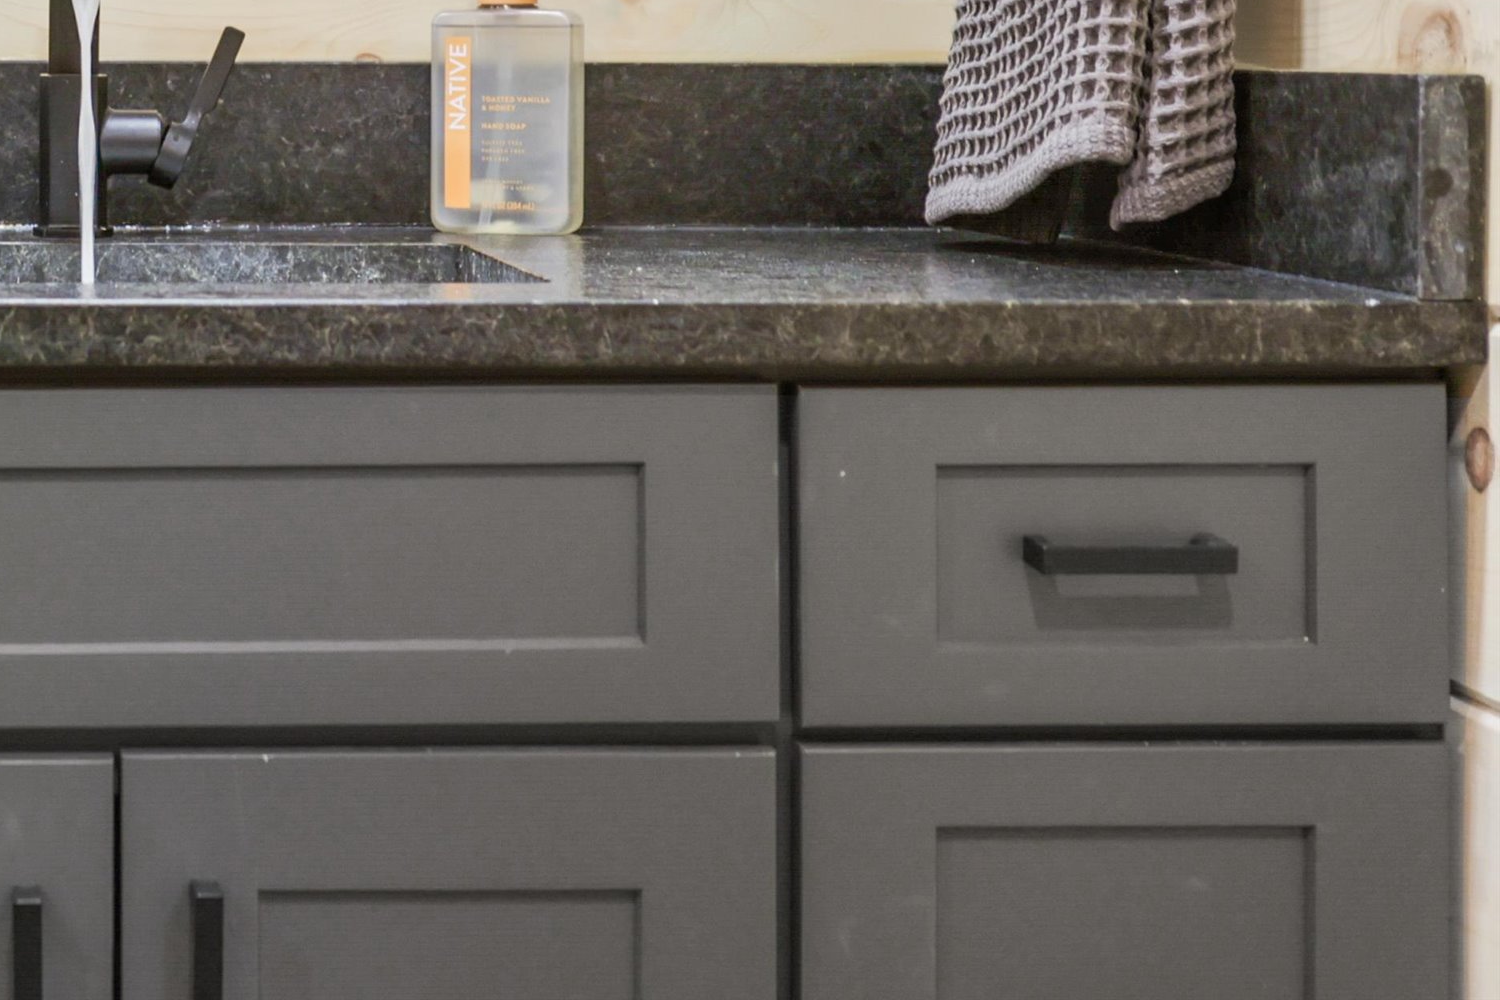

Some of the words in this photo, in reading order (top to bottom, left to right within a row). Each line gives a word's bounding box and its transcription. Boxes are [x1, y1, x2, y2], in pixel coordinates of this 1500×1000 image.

[449, 43, 468, 131] NATIVE
[516, 95, 550, 104] VANILLA
[481, 122, 503, 130] HAND
[505, 122, 527, 130] SOAP
